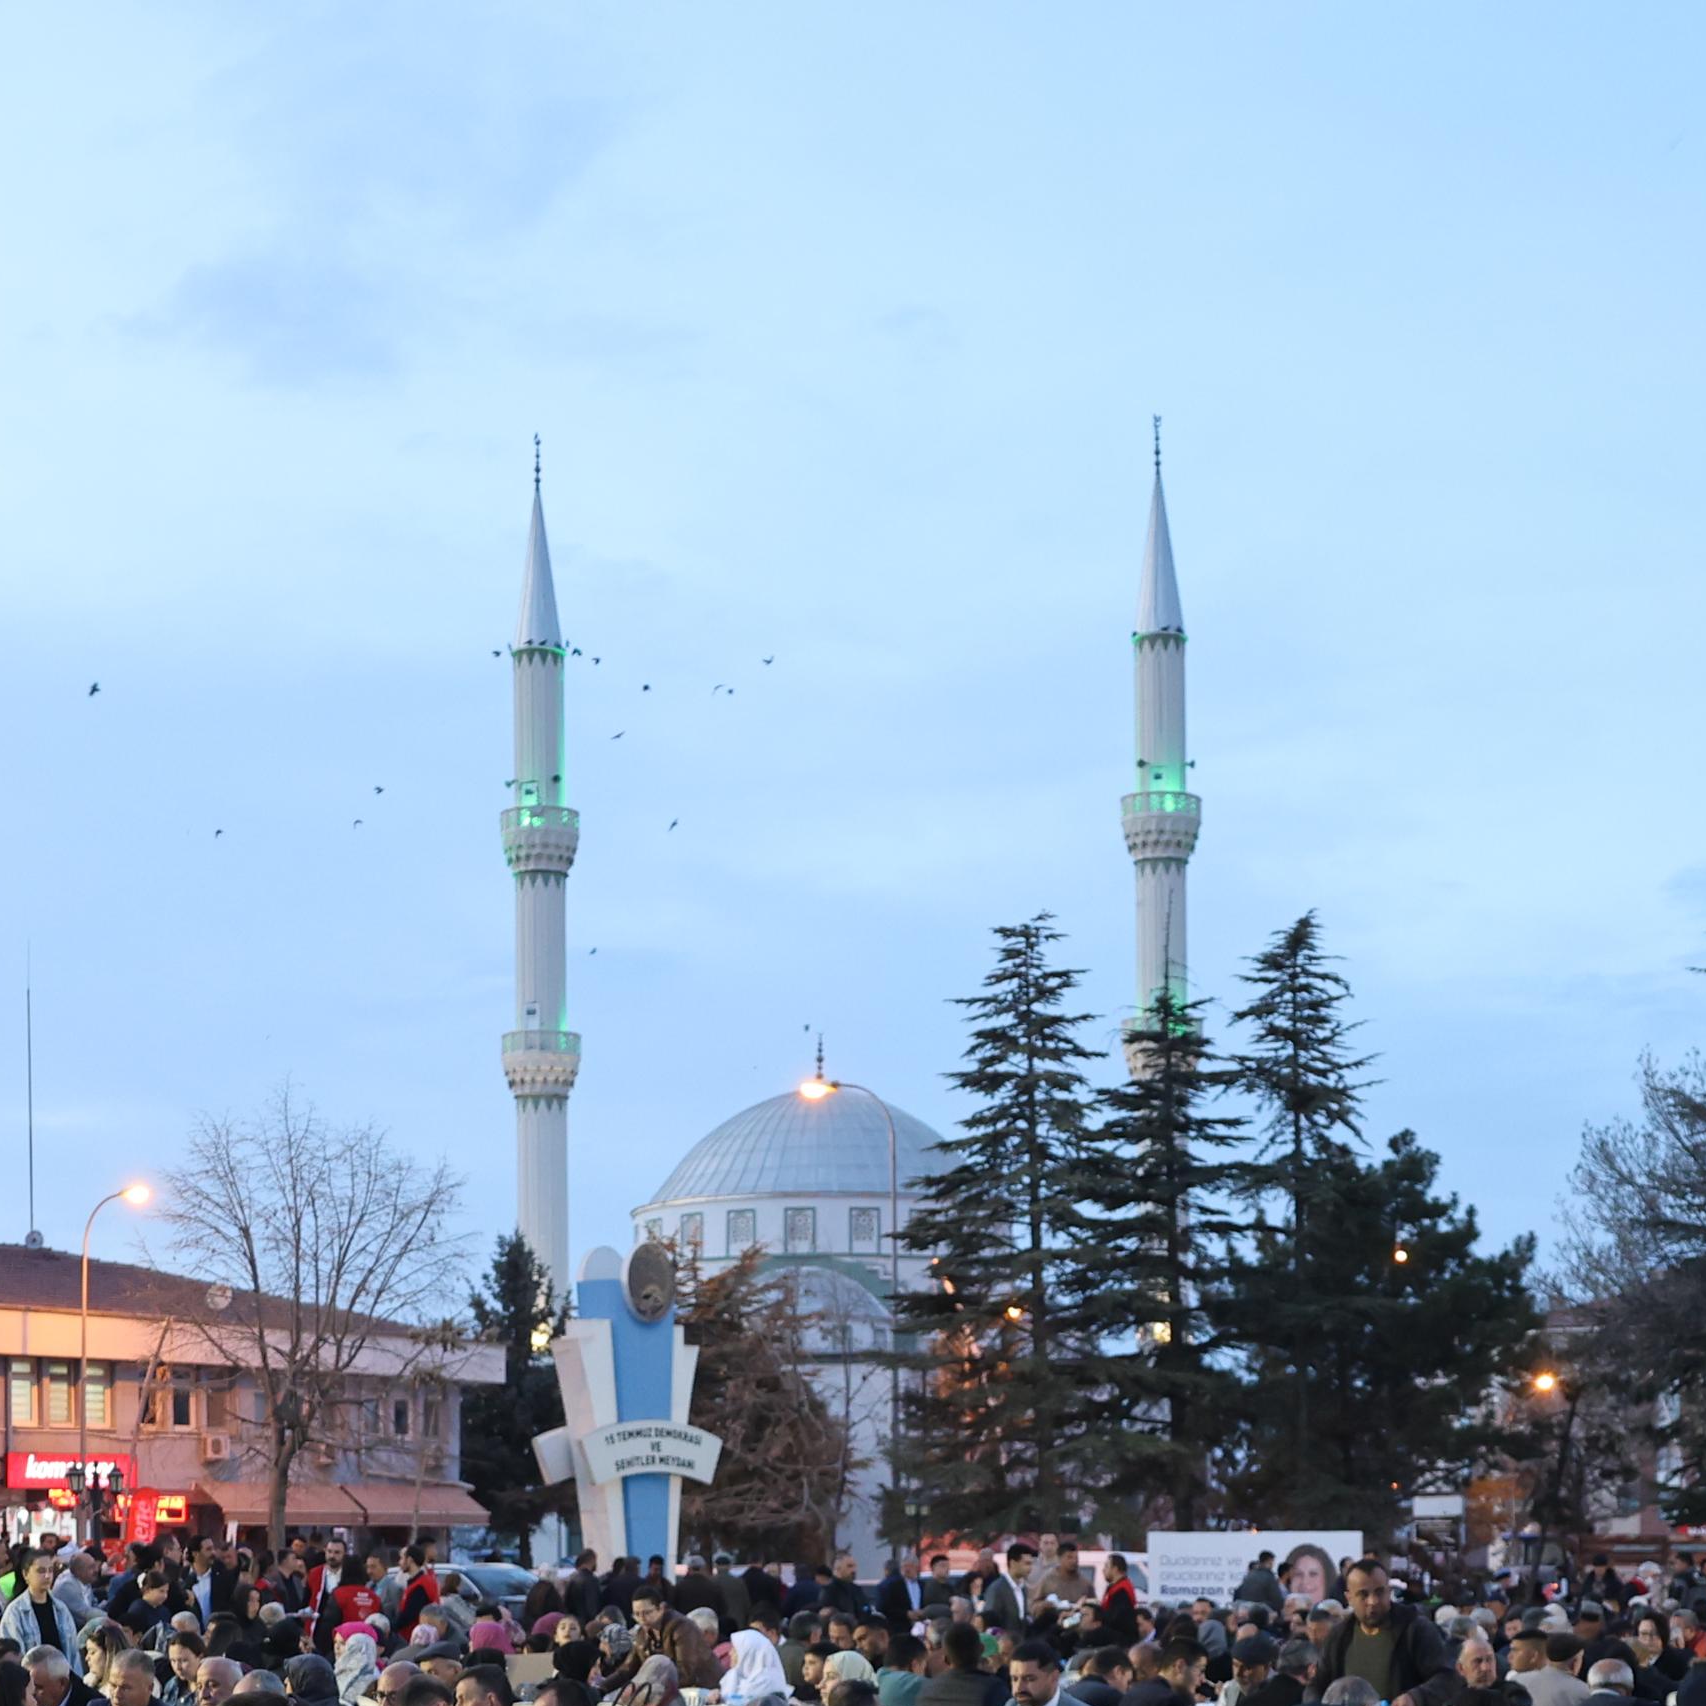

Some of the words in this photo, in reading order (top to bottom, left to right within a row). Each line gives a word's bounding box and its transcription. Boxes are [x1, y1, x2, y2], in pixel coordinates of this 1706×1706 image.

[616, 1427, 653, 1442] TEMMUZ
[650, 1440, 662, 1452] VE
[1160, 1584, 1225, 1595] Ramazan
